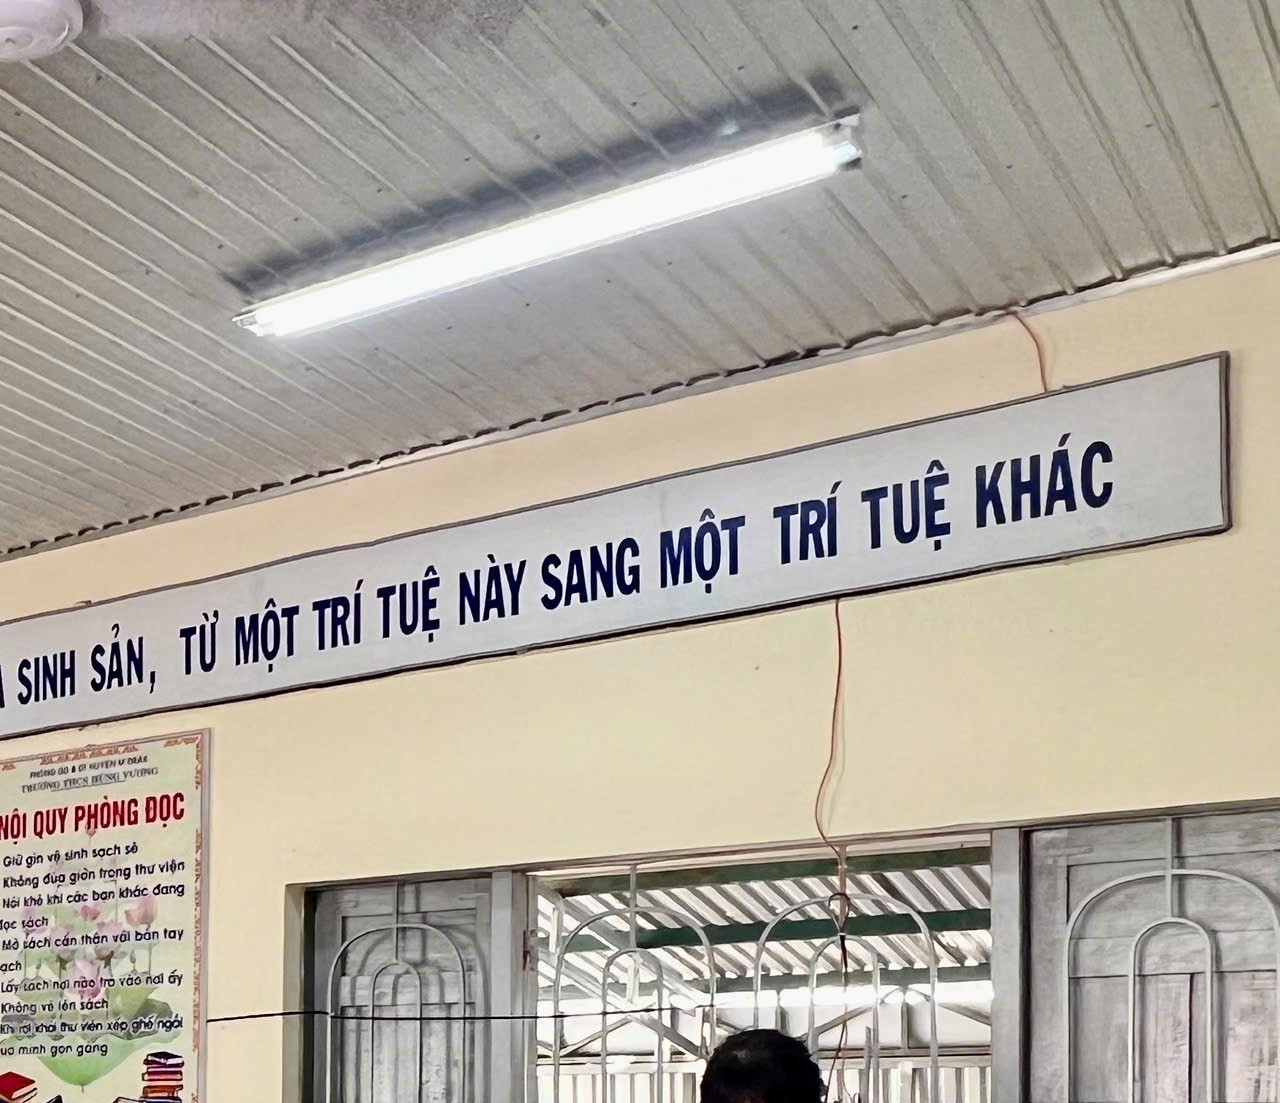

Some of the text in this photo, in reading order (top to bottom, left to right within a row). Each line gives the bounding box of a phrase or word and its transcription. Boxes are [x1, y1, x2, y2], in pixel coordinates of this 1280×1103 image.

[18, 650, 75, 704] SINH
[91, 624, 155, 693] SẢN,
[180, 610, 218, 675] TỪ
[236, 598, 299, 672] MỘT
[312, 579, 363, 650] TRÍ
[377, 565, 440, 642] TUỆ
[460, 554, 526, 625] NÀY
[541, 538, 640, 610] SANG
[660, 509, 745, 593] MỘT
[773, 481, 841, 564] TRÍ
[861, 460, 950, 551] TUỆ
[976, 433, 1113, 528] KHÁC
[33, 807, 68, 840] QUY
[74, 795, 139, 832] PHÒNG
[145, 792, 185, 828] ĐỌC
[65, 847, 88, 861] sinh
[92, 844, 120, 860] sạch
[99, 867, 131, 880] trong
[135, 863, 155, 874] thư
[47, 893, 63, 905] khi
[119, 884, 149, 899] khác
[152, 883, 185, 897] đang
[163, 928, 184, 941] tay
[1, 1002, 37, 1015] Không
[80, 998, 109, 1011] sách
